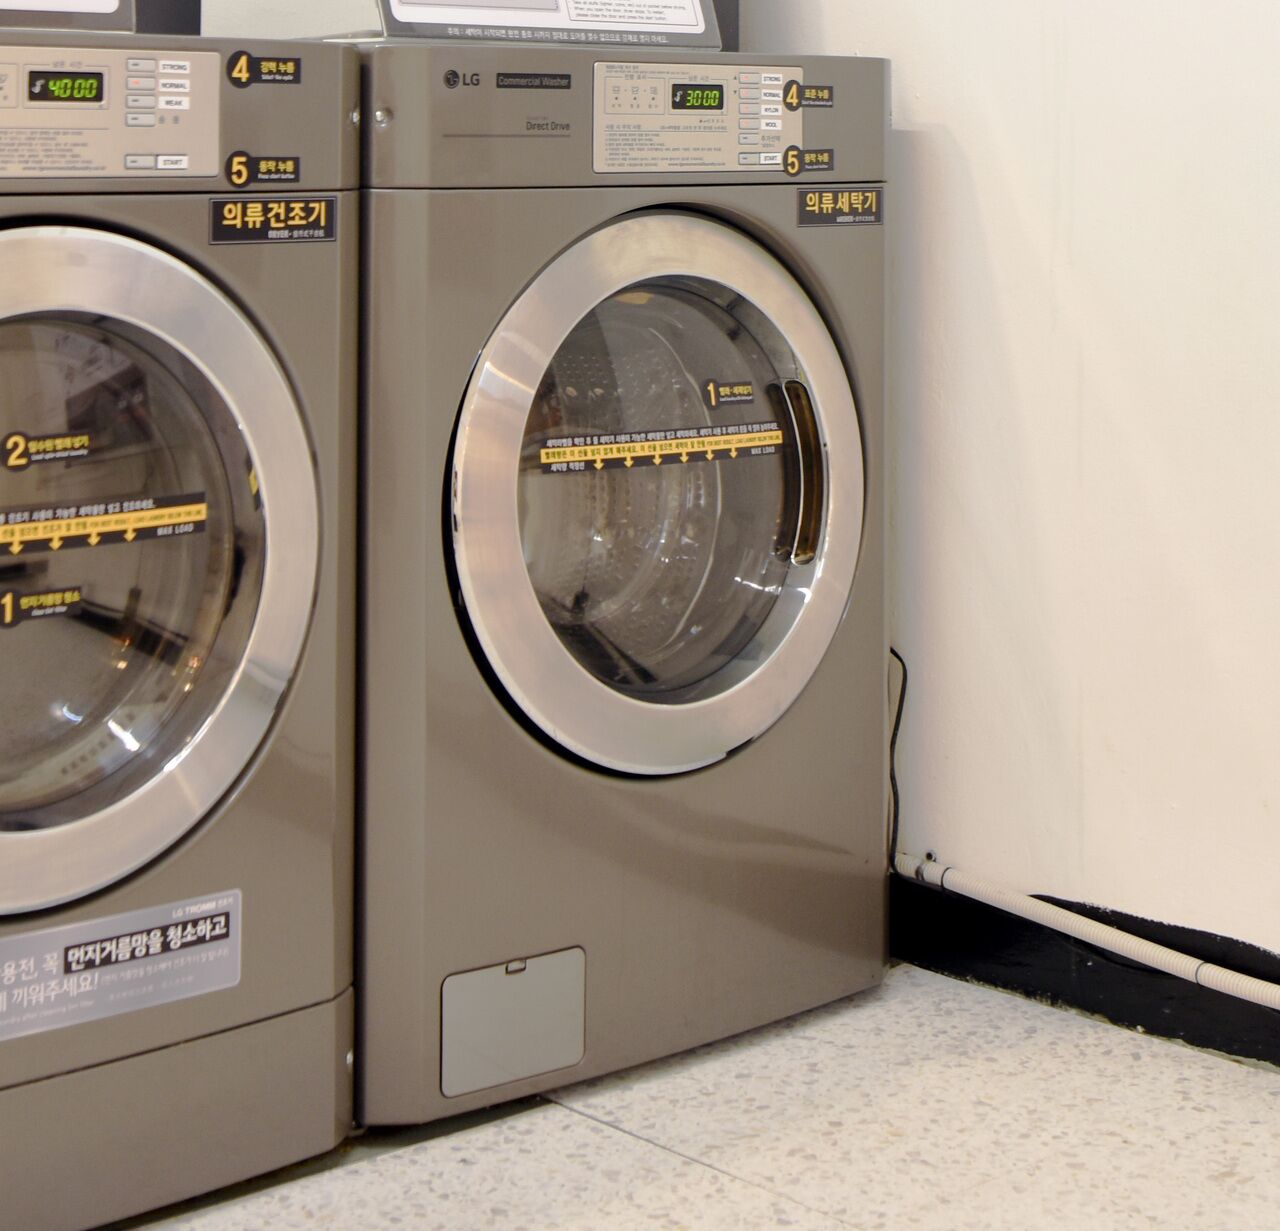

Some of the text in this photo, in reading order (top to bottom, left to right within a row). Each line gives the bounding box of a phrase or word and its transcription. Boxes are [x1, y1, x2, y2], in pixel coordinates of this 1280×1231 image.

[162, 63, 187, 71] STRONG
[231, 55, 249, 83] 4
[48, 79, 98, 98] 4000
[462, 73, 480, 86] LG
[498, 76, 569, 87] Commercial Washer
[686, 90, 719, 106] 3000
[786, 84, 798, 107] 4
[526, 121, 570, 131] Direct Drive
[231, 156, 248, 184] 5
[787, 150, 798, 174] 5
[222, 202, 325, 229] 의류건조기
[707, 382, 716, 406] 1
[6, 434, 28, 466] 2
[1, 592, 13, 624] 1
[42, 952, 59, 975] 꼭
[68, 928, 163, 971] 먼지거름망을
[166, 915, 227, 950] 청소하고
[12, 973, 99, 1008] 끼워주세요!
